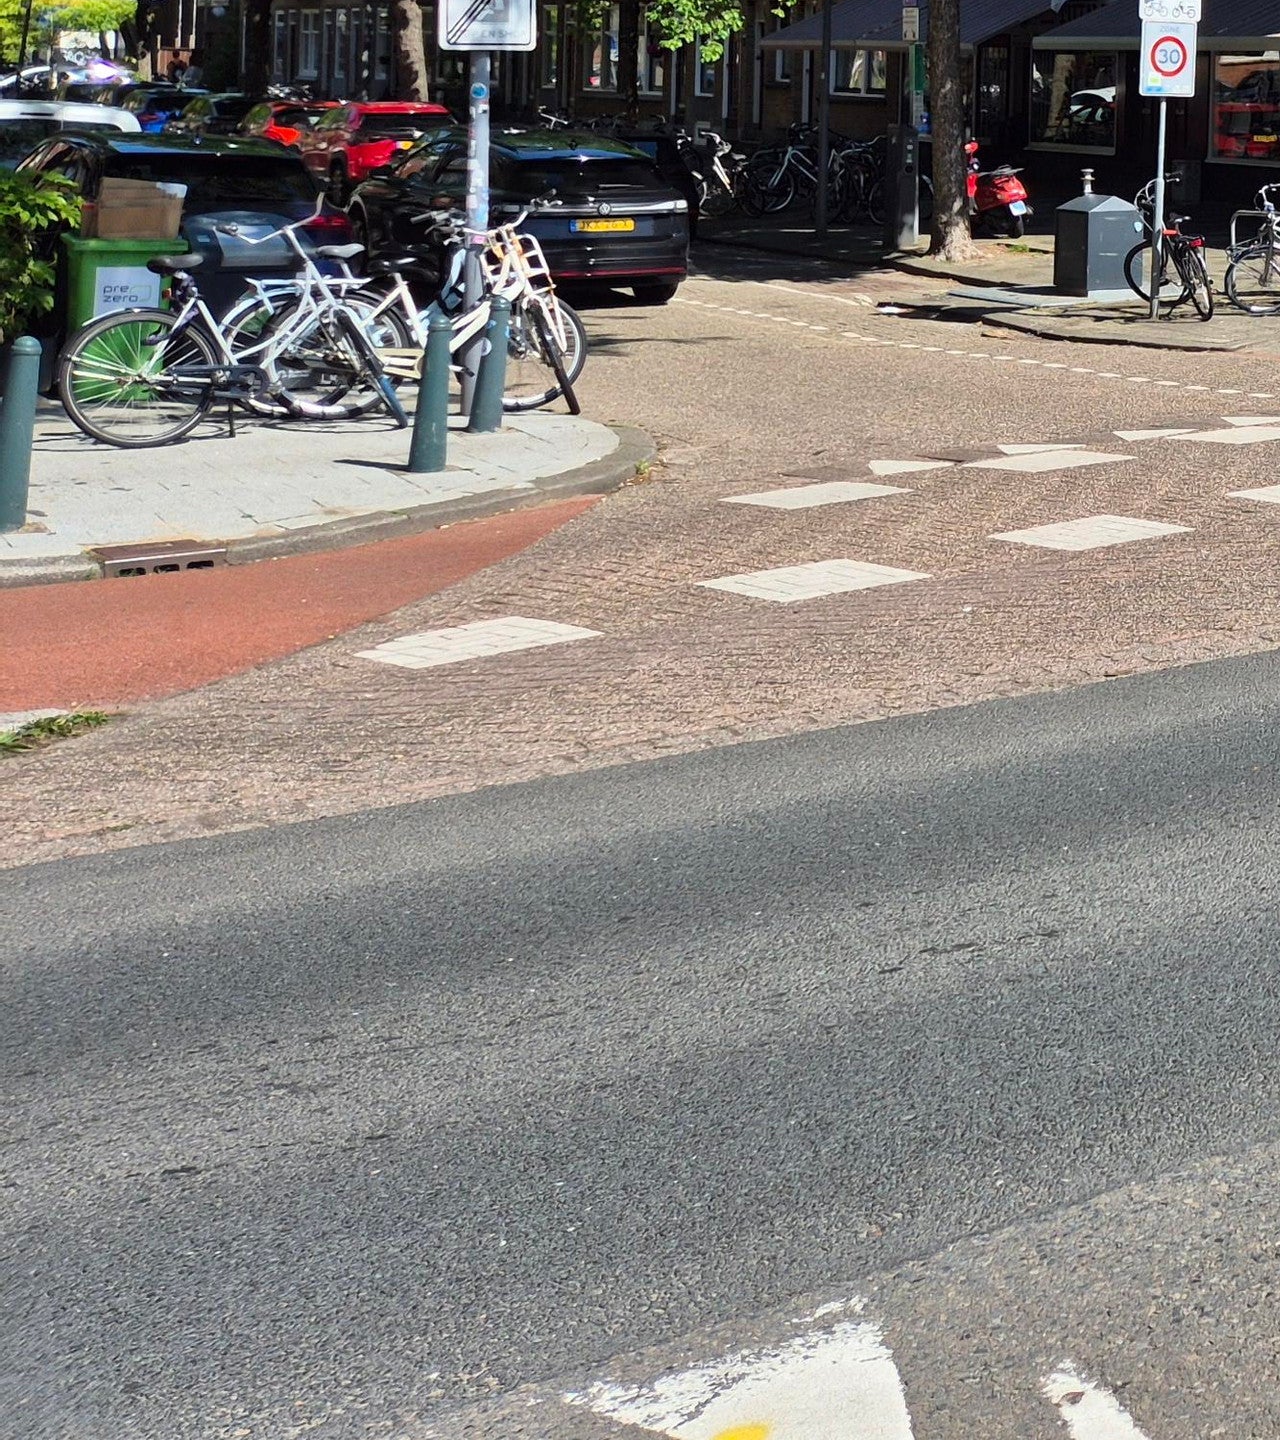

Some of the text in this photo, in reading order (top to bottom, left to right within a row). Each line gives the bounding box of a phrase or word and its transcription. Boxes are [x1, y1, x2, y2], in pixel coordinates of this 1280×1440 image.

[1158, 48, 1180, 65] 30
[103, 285, 130, 294] pre
[103, 295, 139, 303] zero
